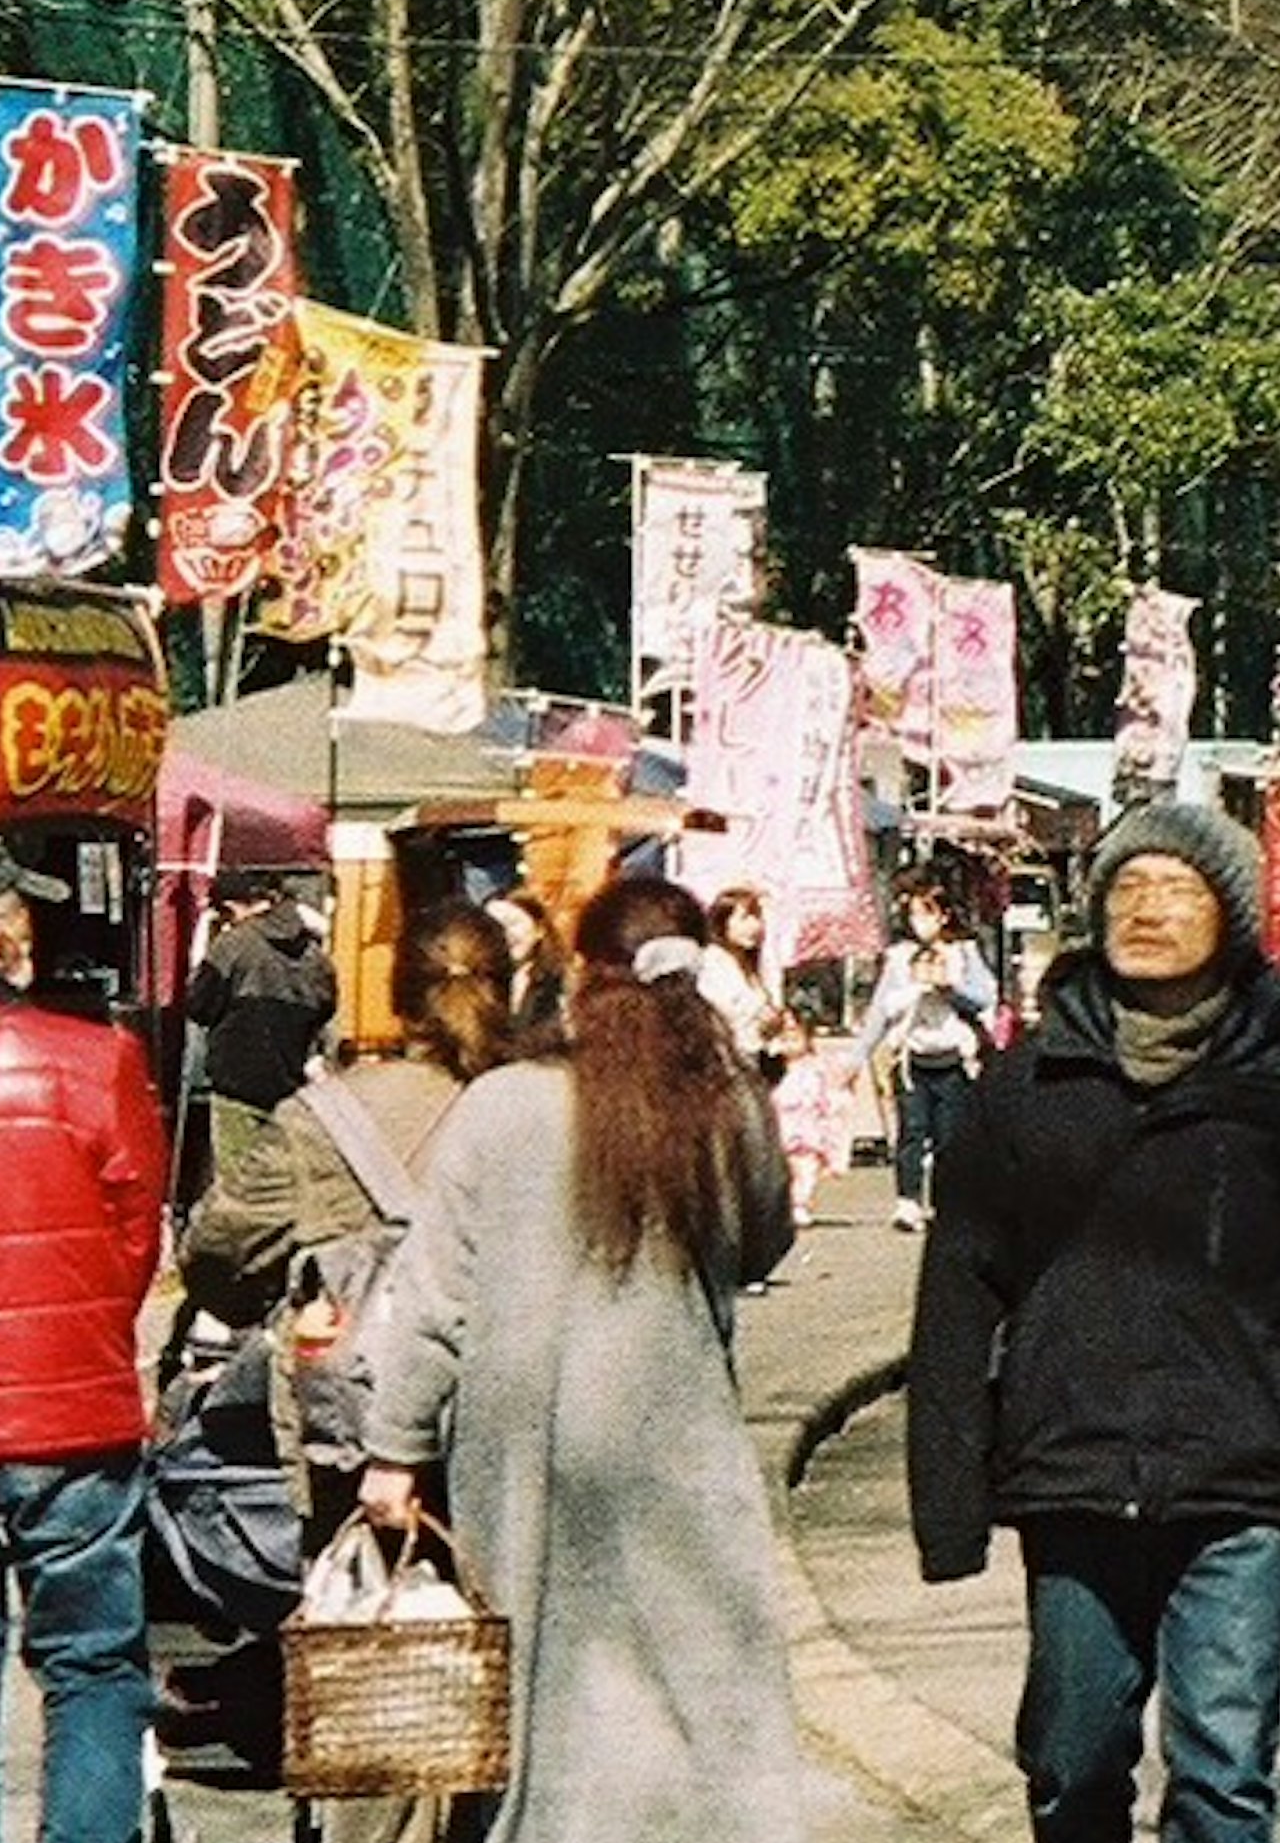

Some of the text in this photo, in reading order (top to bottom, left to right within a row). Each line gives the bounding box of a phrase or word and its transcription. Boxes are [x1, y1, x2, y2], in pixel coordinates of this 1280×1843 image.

[4, 112, 118, 484] かき氷
[164, 163, 291, 504] うどん
